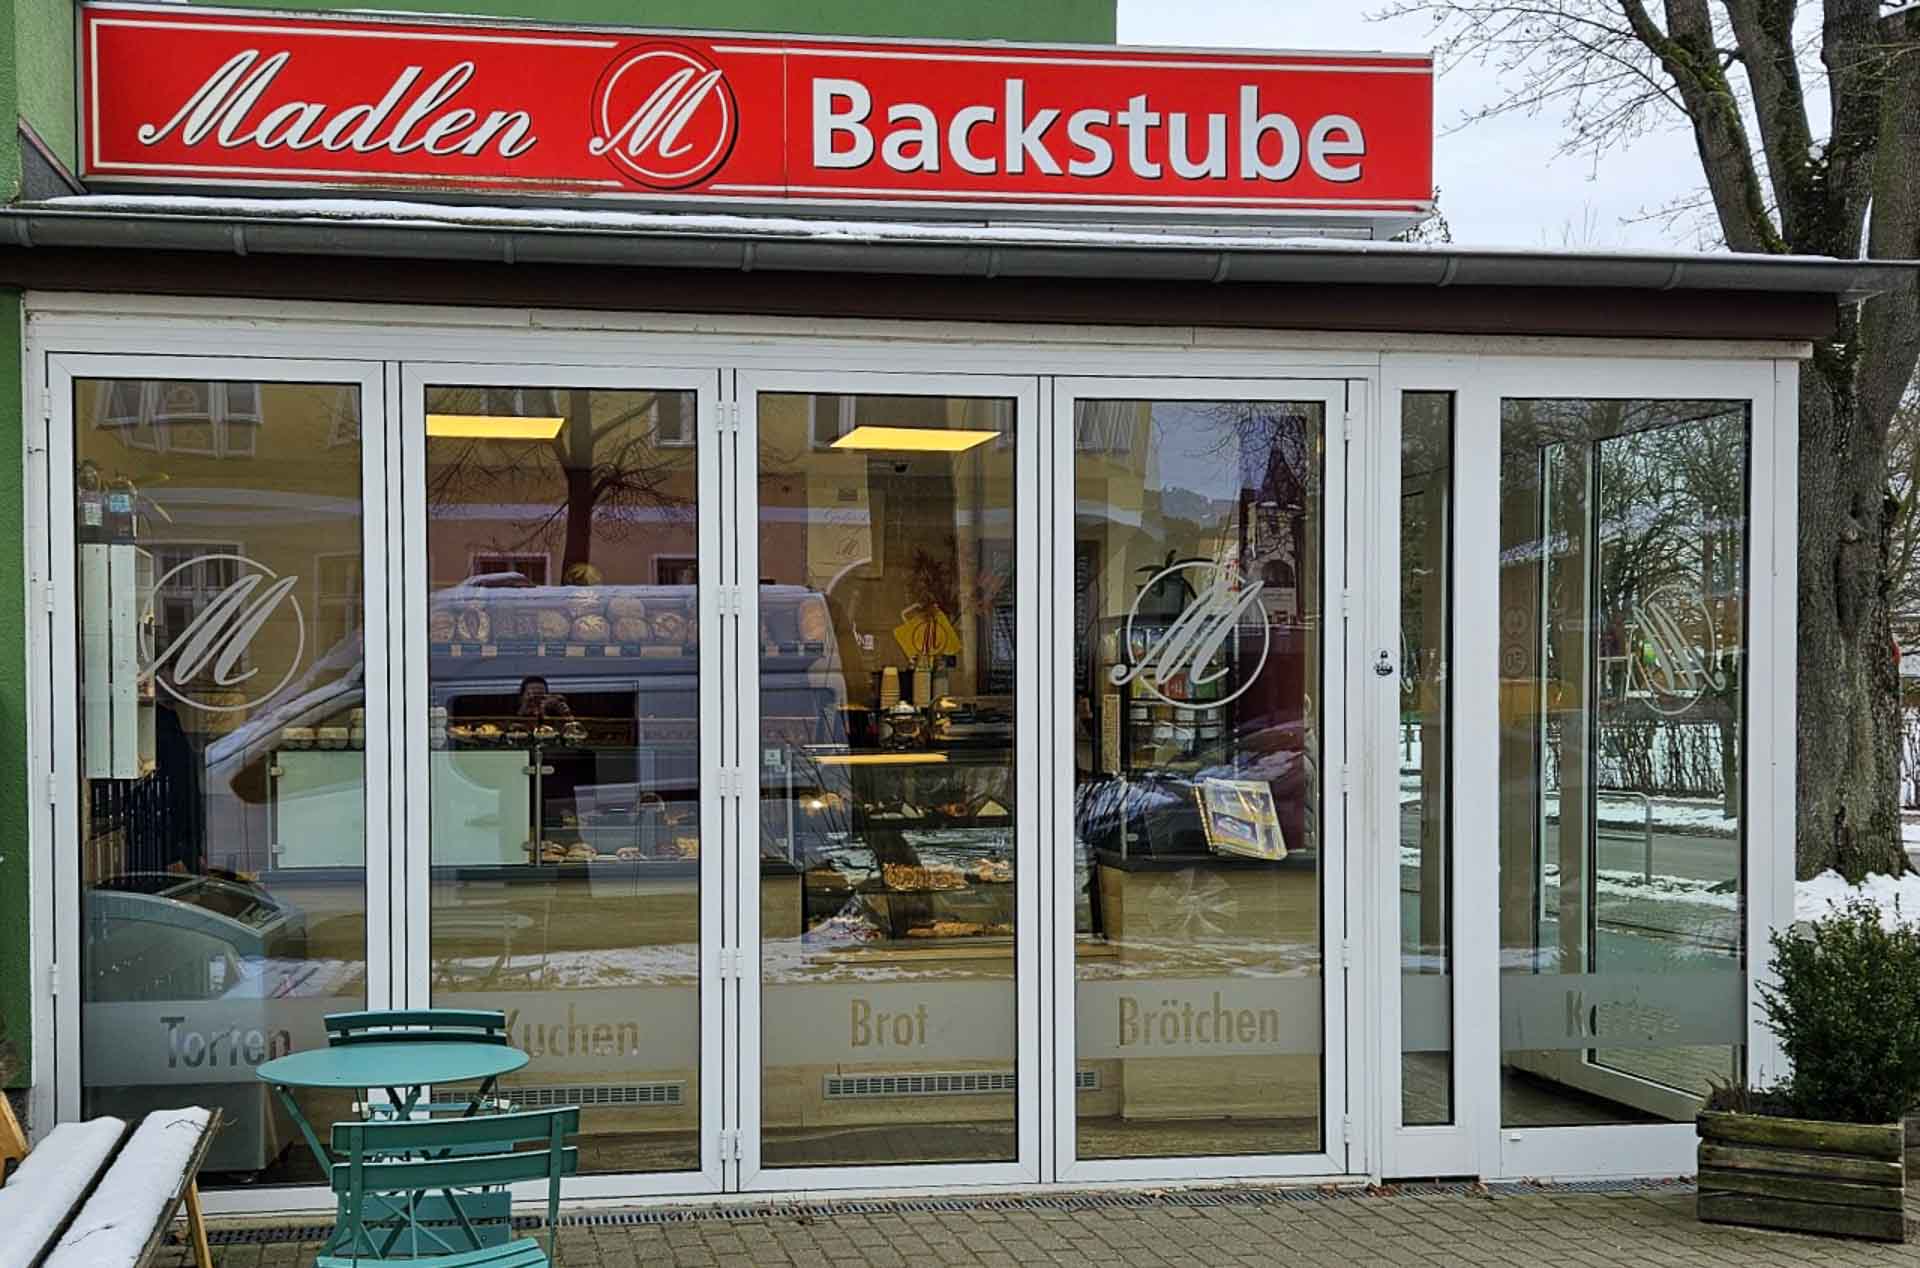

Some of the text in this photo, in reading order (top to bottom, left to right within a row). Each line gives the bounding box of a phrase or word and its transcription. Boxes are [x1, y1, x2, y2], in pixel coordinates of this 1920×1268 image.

[137, 48, 1367, 183] Madlen M Backstube
[136, 574, 299, 686] M
[1111, 577, 1265, 687] M
[850, 998, 929, 1049] Brot
[1117, 991, 1281, 1047] Brötchen
